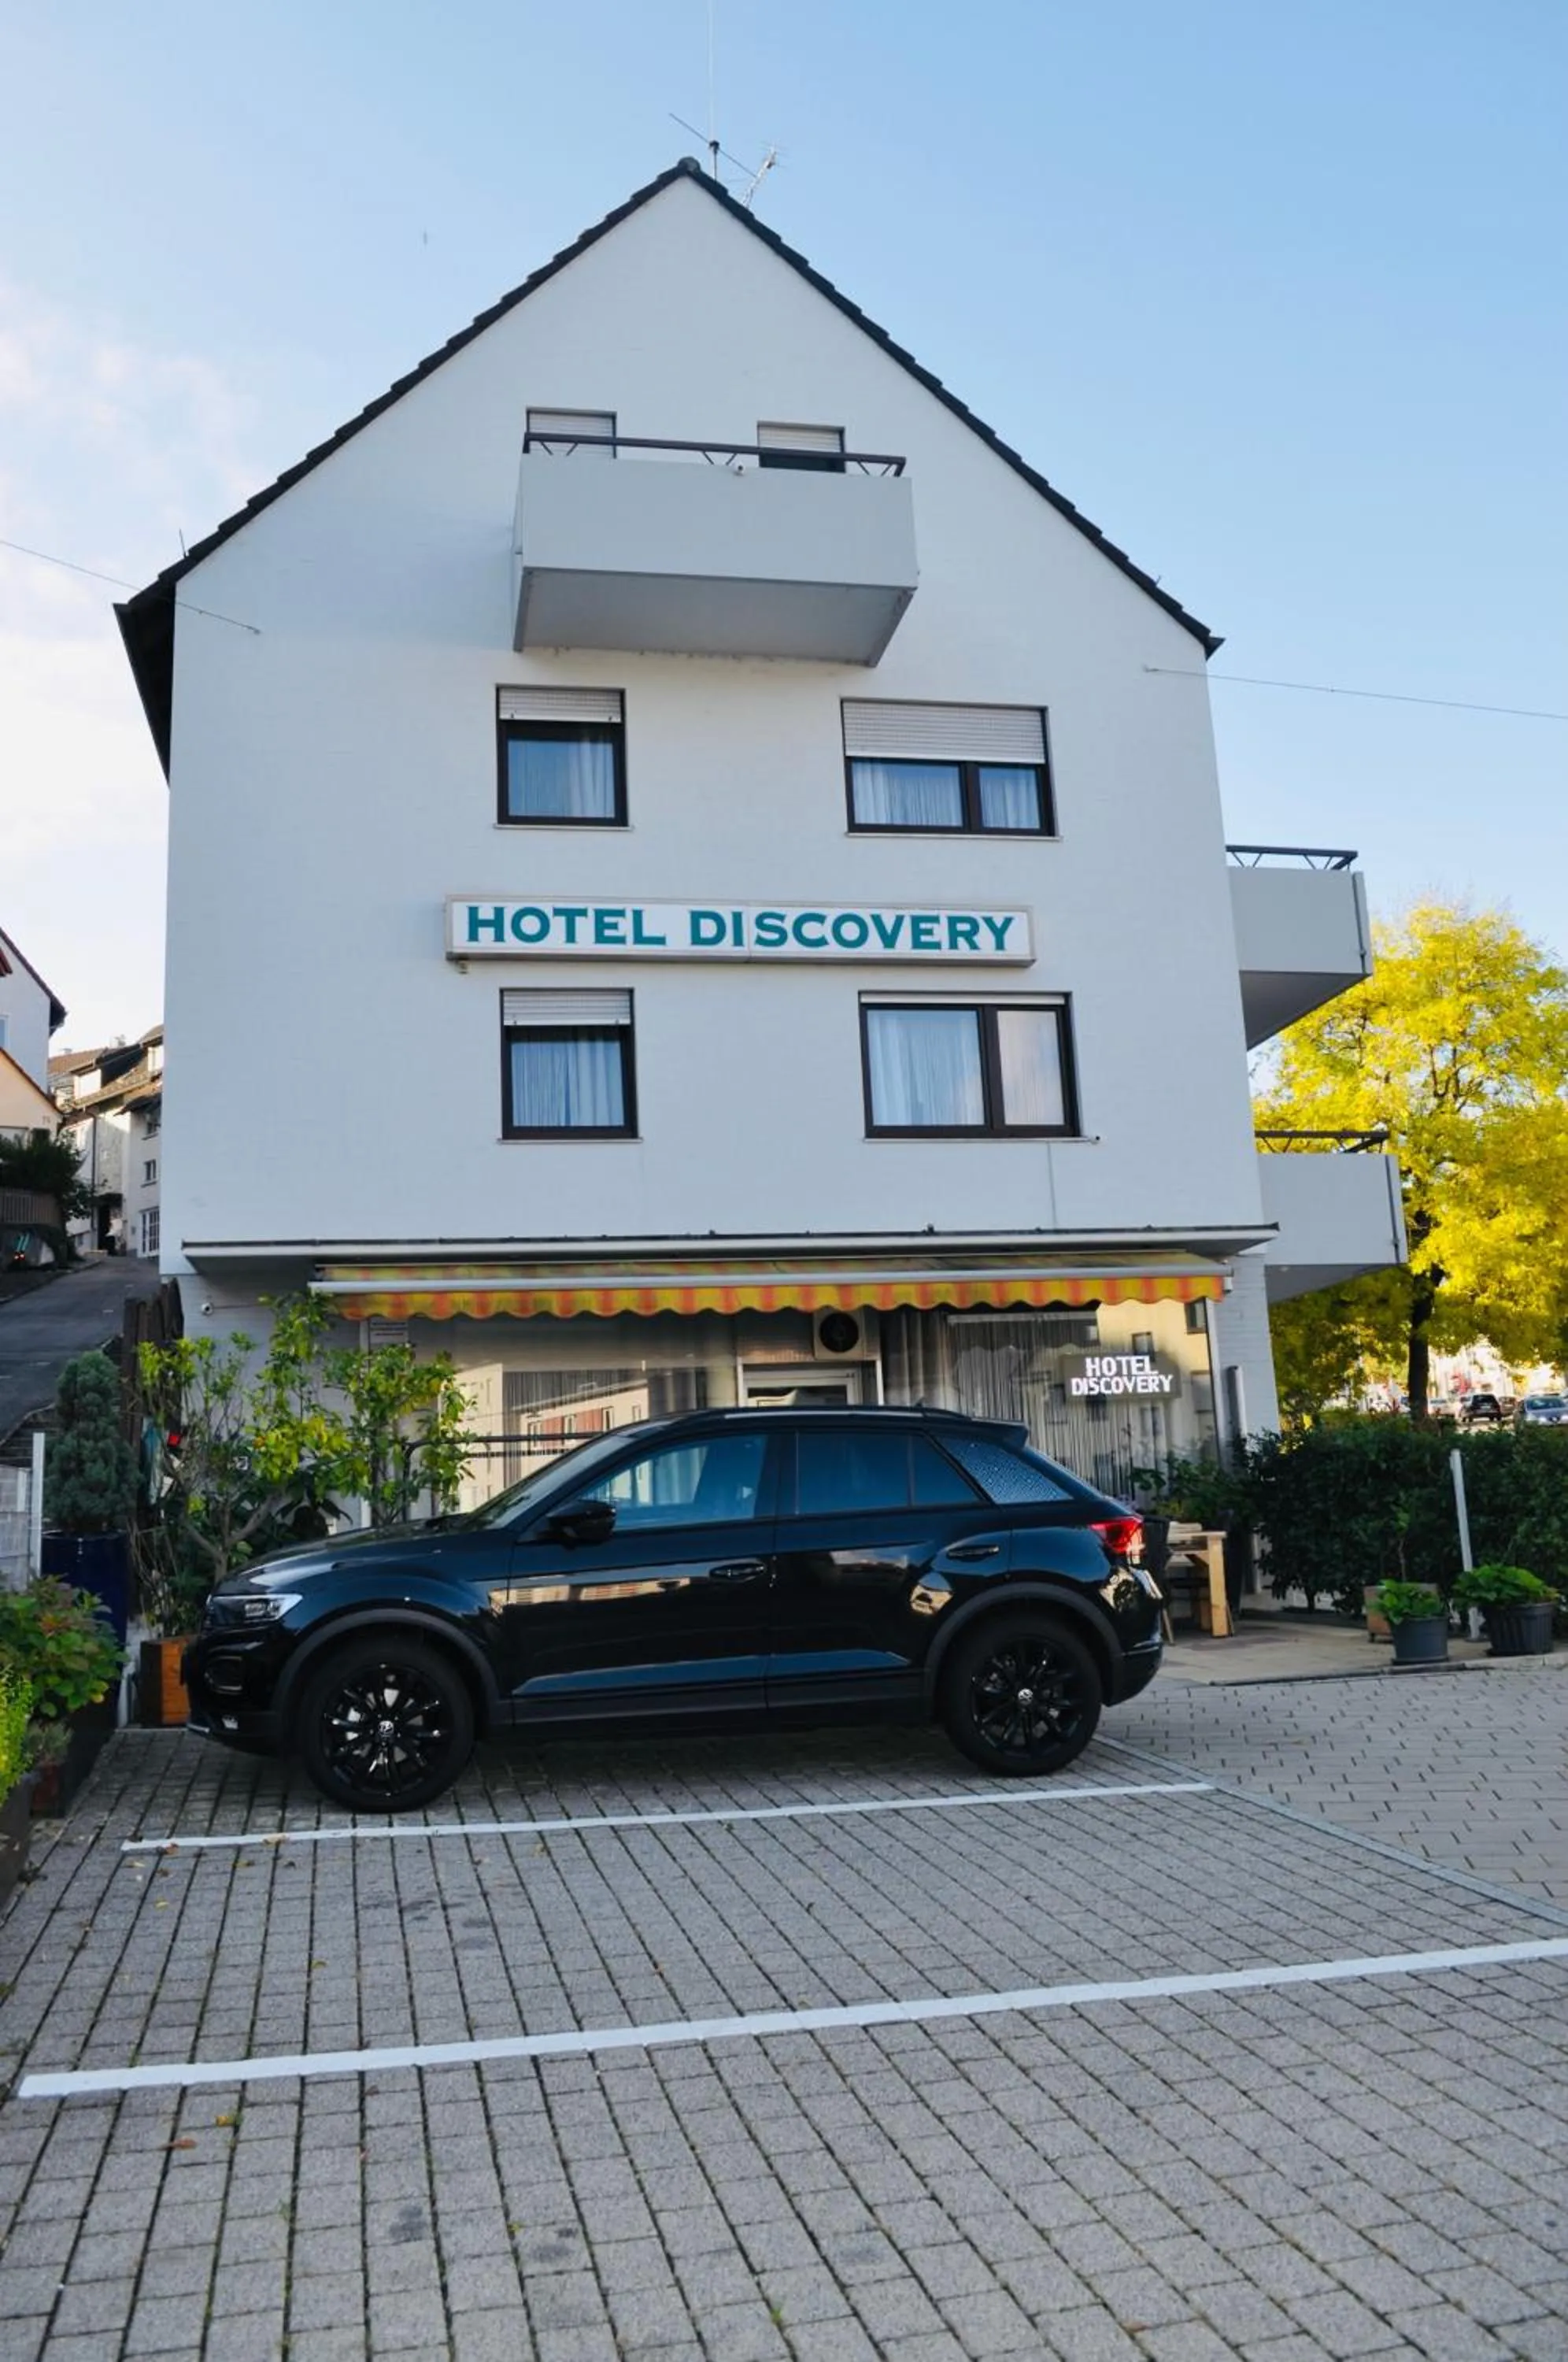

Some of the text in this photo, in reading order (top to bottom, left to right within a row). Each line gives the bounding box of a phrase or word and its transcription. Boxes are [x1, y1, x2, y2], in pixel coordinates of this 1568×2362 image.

[467, 906, 1015, 951] HOTEL DISCOVERY
[1085, 1355, 1159, 1377] HOTEL
[1071, 1375, 1173, 1396] DISCOVERY
